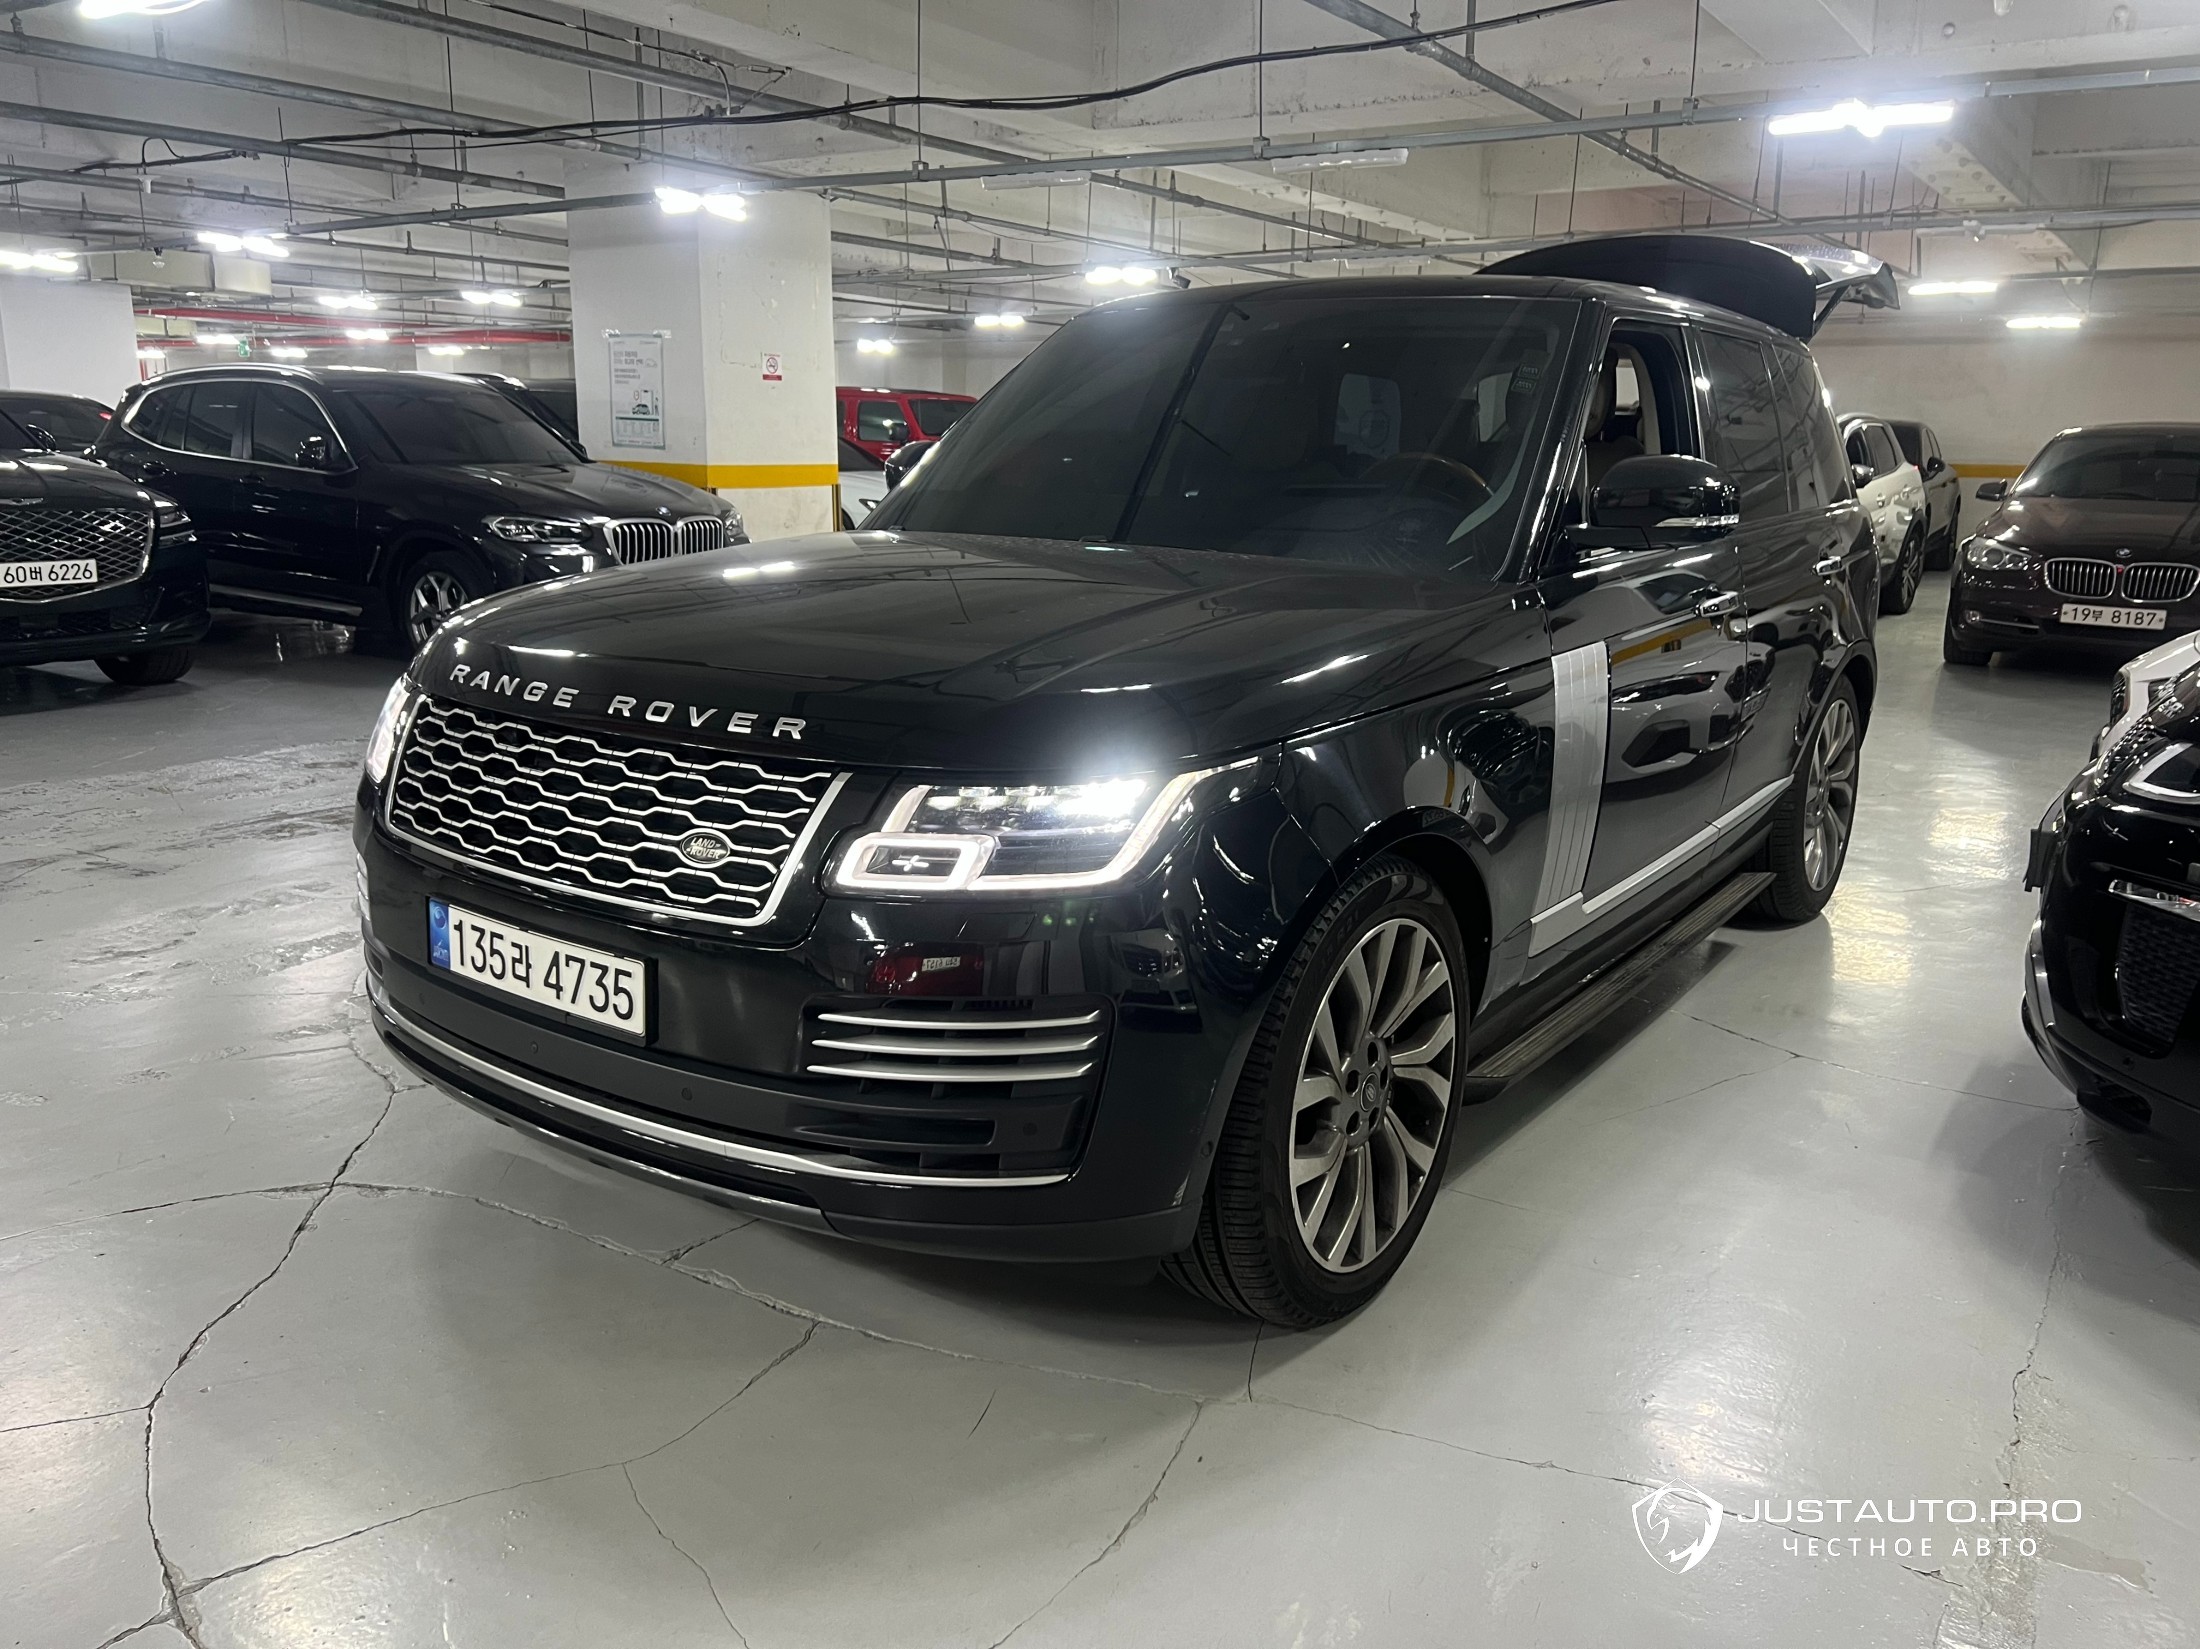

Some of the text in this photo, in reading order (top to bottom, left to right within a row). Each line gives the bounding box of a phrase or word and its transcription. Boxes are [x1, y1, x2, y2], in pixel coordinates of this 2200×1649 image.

[3, 563, 93, 584] 60버 6226
[2072, 606, 2156, 626] 19부 8187
[449, 663, 807, 740] RANGE ROVER
[690, 846, 720, 859] ROVER
[691, 837, 715, 848] LAND
[453, 919, 634, 1021] 135라 4735
